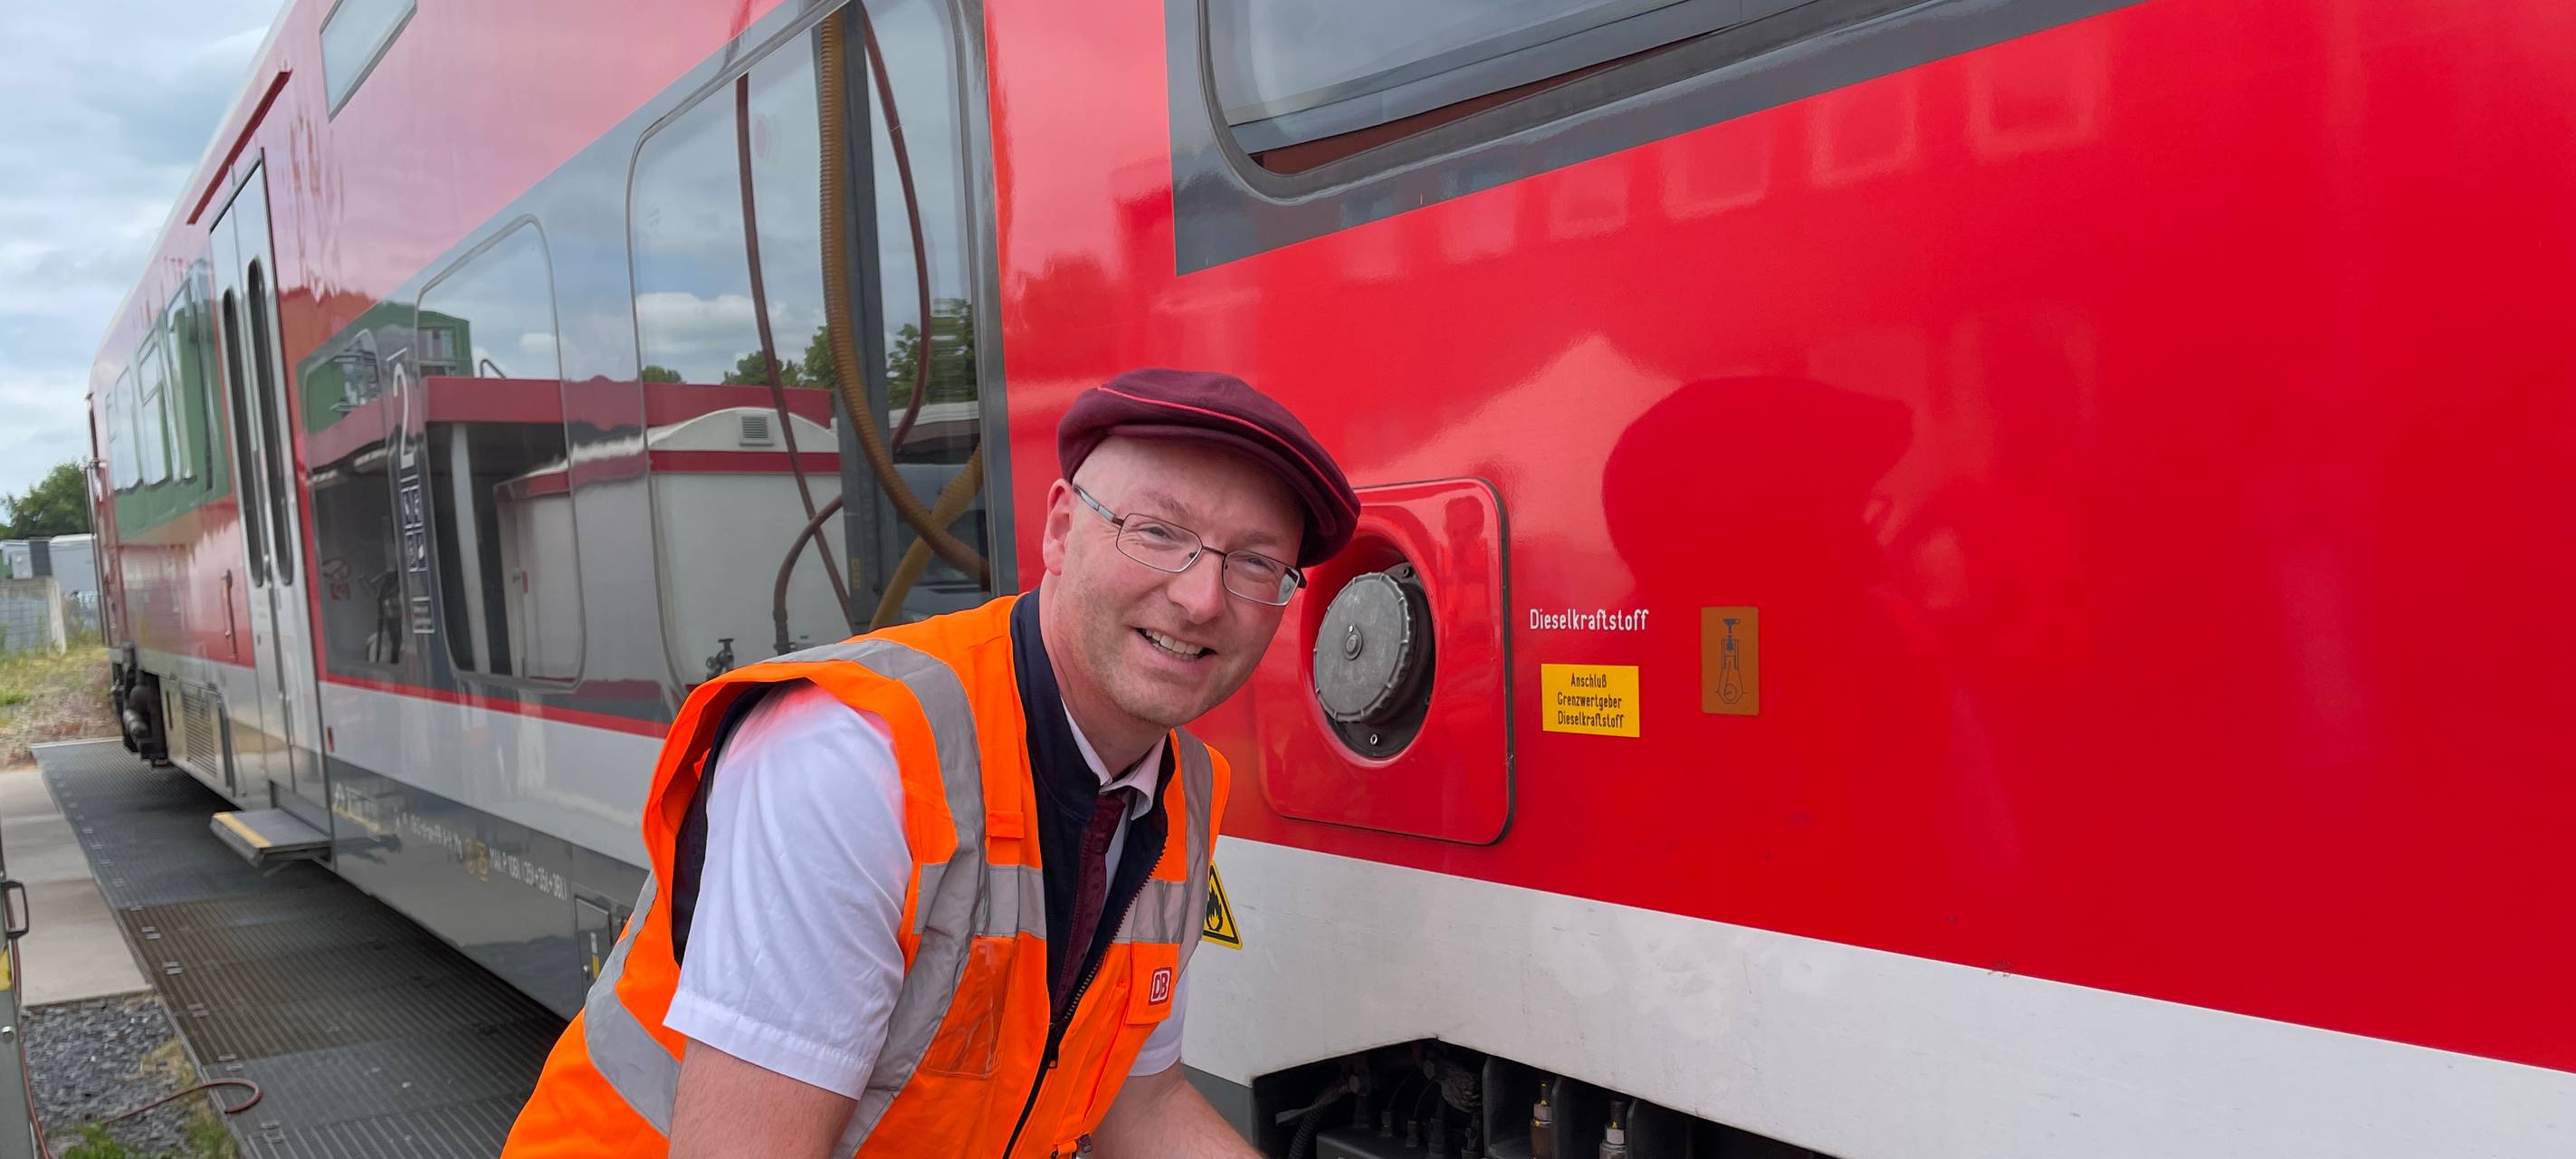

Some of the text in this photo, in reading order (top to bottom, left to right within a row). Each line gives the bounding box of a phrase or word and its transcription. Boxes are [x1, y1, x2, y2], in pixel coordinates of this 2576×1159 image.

[393, 363, 415, 469] 2
[1530, 608, 1649, 631] Dieselkraftstoff
[1570, 673, 1608, 688] Anschluß
[1557, 691, 1622, 711] Grenzwertgeber
[1558, 710, 1625, 729] Dieselkraftstoff
[1151, 972, 1169, 1001] DB
